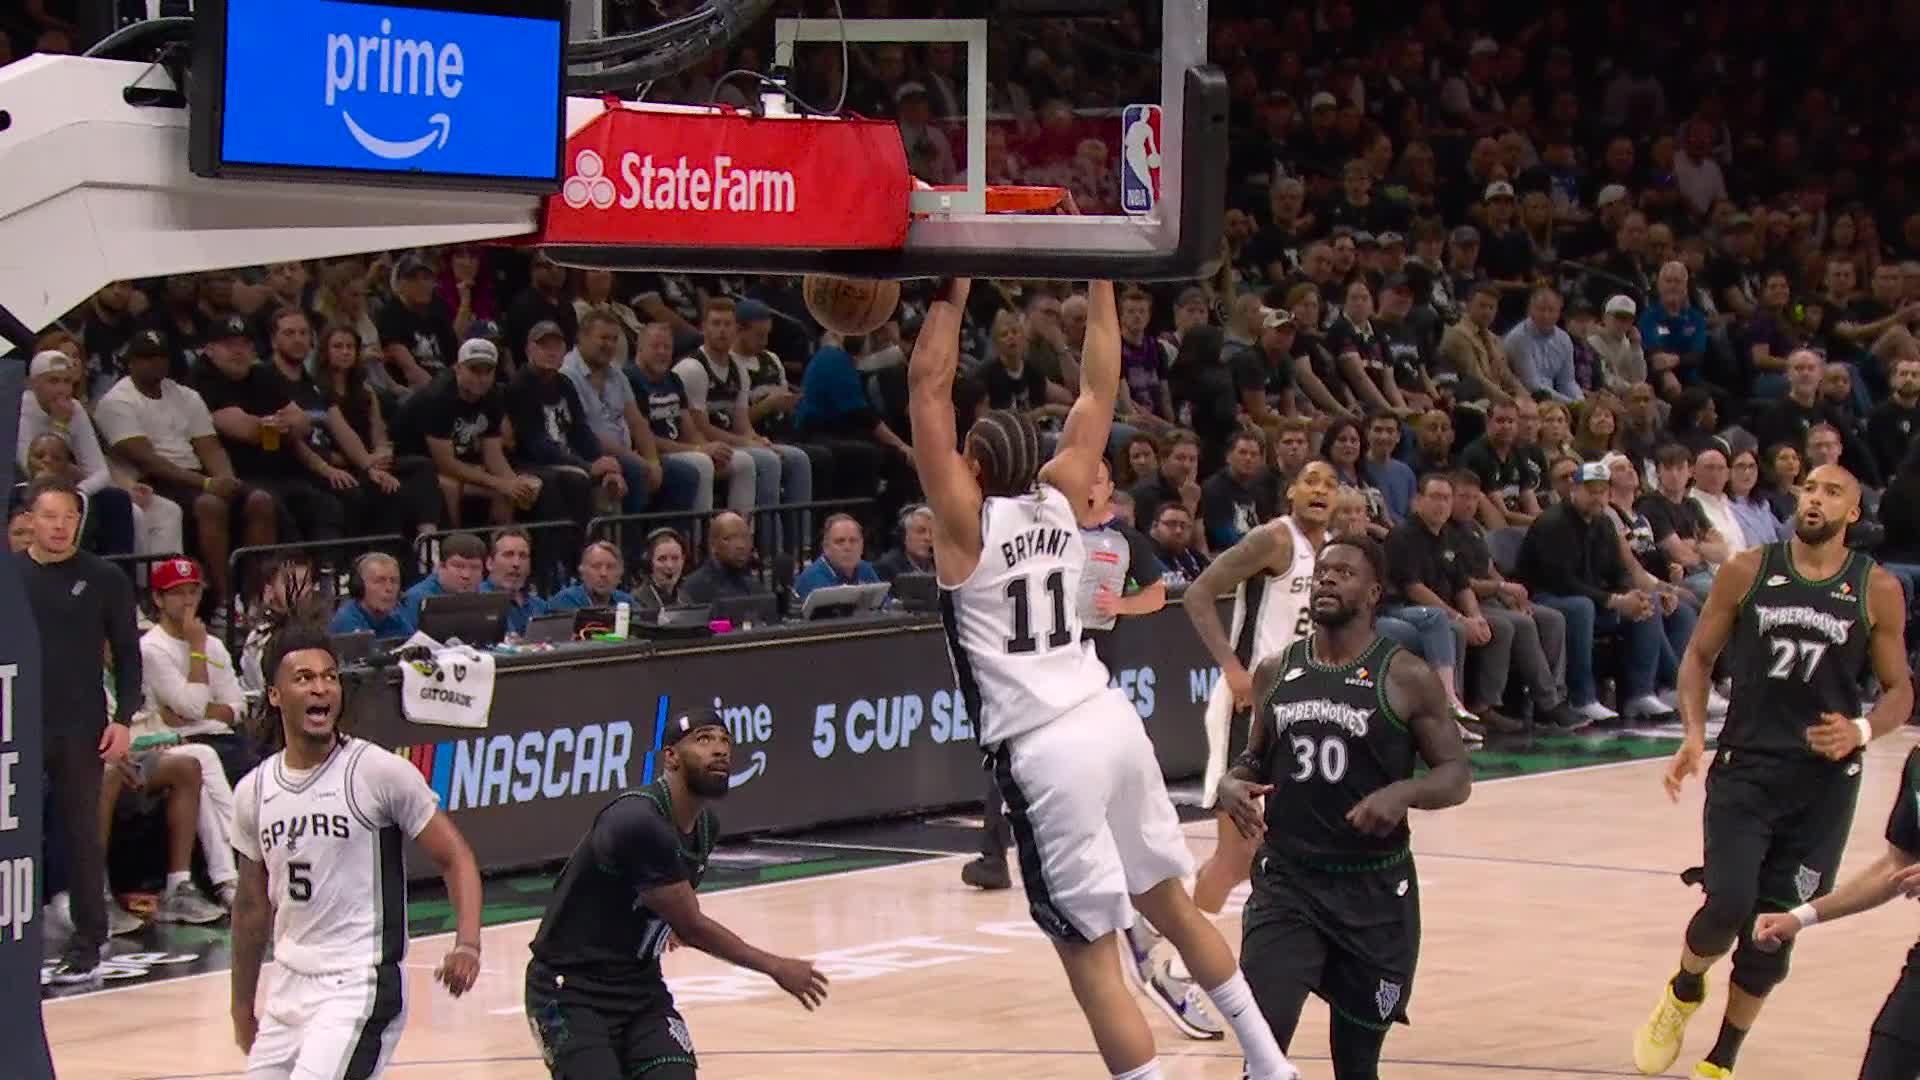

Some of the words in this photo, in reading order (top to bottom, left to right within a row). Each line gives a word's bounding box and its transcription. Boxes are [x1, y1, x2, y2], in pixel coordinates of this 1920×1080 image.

[326, 17, 464, 106] prime
[1127, 189, 1147, 207] NBA
[1001, 528, 1072, 568] BRYANT
[1003, 568, 1074, 656] 11
[1755, 602, 1856, 646] TIMBERWOLVES
[1766, 634, 1830, 683] 27
[713, 696, 774, 745] ime
[812, 703, 837, 758] 5
[845, 693, 924, 753] CUP
[1272, 697, 1377, 738] TIMBERWOLVES
[448, 720, 634, 811] NASCAR
[1289, 733, 1349, 785] 30
[261, 812, 350, 853] SPURS
[287, 861, 312, 902] 5
